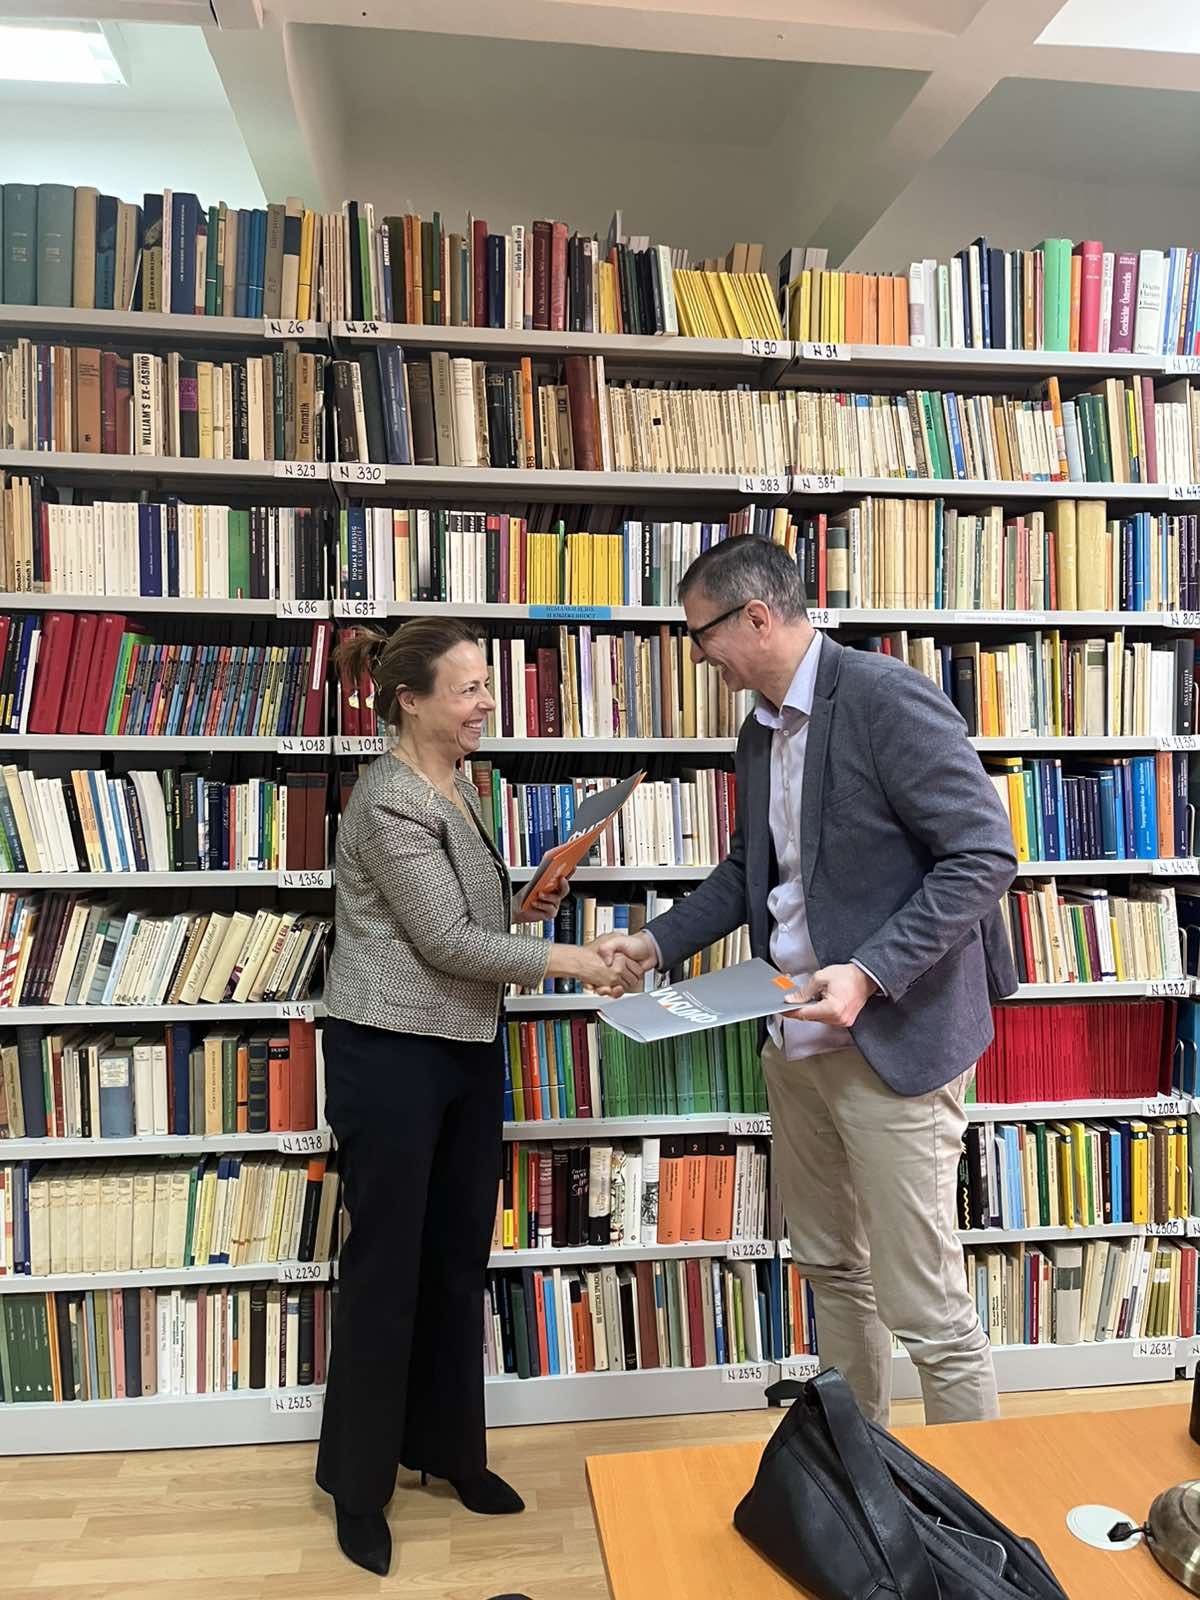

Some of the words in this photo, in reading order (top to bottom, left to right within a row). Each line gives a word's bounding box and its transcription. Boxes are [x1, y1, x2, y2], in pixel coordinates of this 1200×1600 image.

[271, 322, 282, 334] N
[288, 321, 304, 334] 26
[1119, 306, 1130, 336] Geschichte
[346, 322, 357, 334] N
[752, 341, 760, 355] N
[764, 342, 776, 356] 90
[813, 345, 822, 356] N
[826, 344, 838, 358] 91
[140, 356, 151, 400] EX-CASINO
[142, 402, 152, 446] WILLIAM'S
[300, 402, 310, 444] Grammatik
[285, 464, 294, 476] N
[297, 464, 316, 477] 329
[340, 466, 349, 478] N
[356, 466, 381, 480] 330
[746, 478, 754, 491] N
[760, 478, 780, 491] 383
[802, 478, 810, 489] N
[818, 476, 836, 488] 384
[1174, 487, 1183, 498] N
[284, 603, 292, 614] N
[298, 600, 318, 614] 686
[342, 603, 350, 614] N
[354, 602, 376, 615] 687
[1170, 612, 1179, 625] N
[1183, 612, 1200, 626] 805
[283, 741, 293, 750] N
[300, 740, 326, 752] 1018
[342, 741, 350, 752] N
[358, 738, 384, 752] 1019
[284, 876, 293, 886] N
[298, 872, 324, 886] 1356
[272, 935, 284, 953] Frau
[1152, 984, 1160, 995] N
[1162, 984, 1186, 996] 1782
[282, 1008, 290, 1016] N
[1148, 1104, 1156, 1114] N
[1158, 1102, 1180, 1114] 2081
[734, 1124, 742, 1133] N
[747, 1120, 772, 1133] 2025
[283, 1140, 292, 1152] N
[296, 1136, 322, 1151] 1978
[1146, 1223, 1153, 1234] N
[732, 1246, 740, 1256] N
[743, 1244, 767, 1256] 2263
[284, 1270, 292, 1280] N
[296, 1265, 320, 1279] 2230
[1140, 1345, 1147, 1354] N
[1150, 1344, 1171, 1355] 2631
[728, 1370, 735, 1380] N
[739, 1368, 762, 1379] 2575
[788, 1367, 796, 1376] N
[276, 1400, 284, 1410] N
[288, 1396, 312, 1410] 2525
